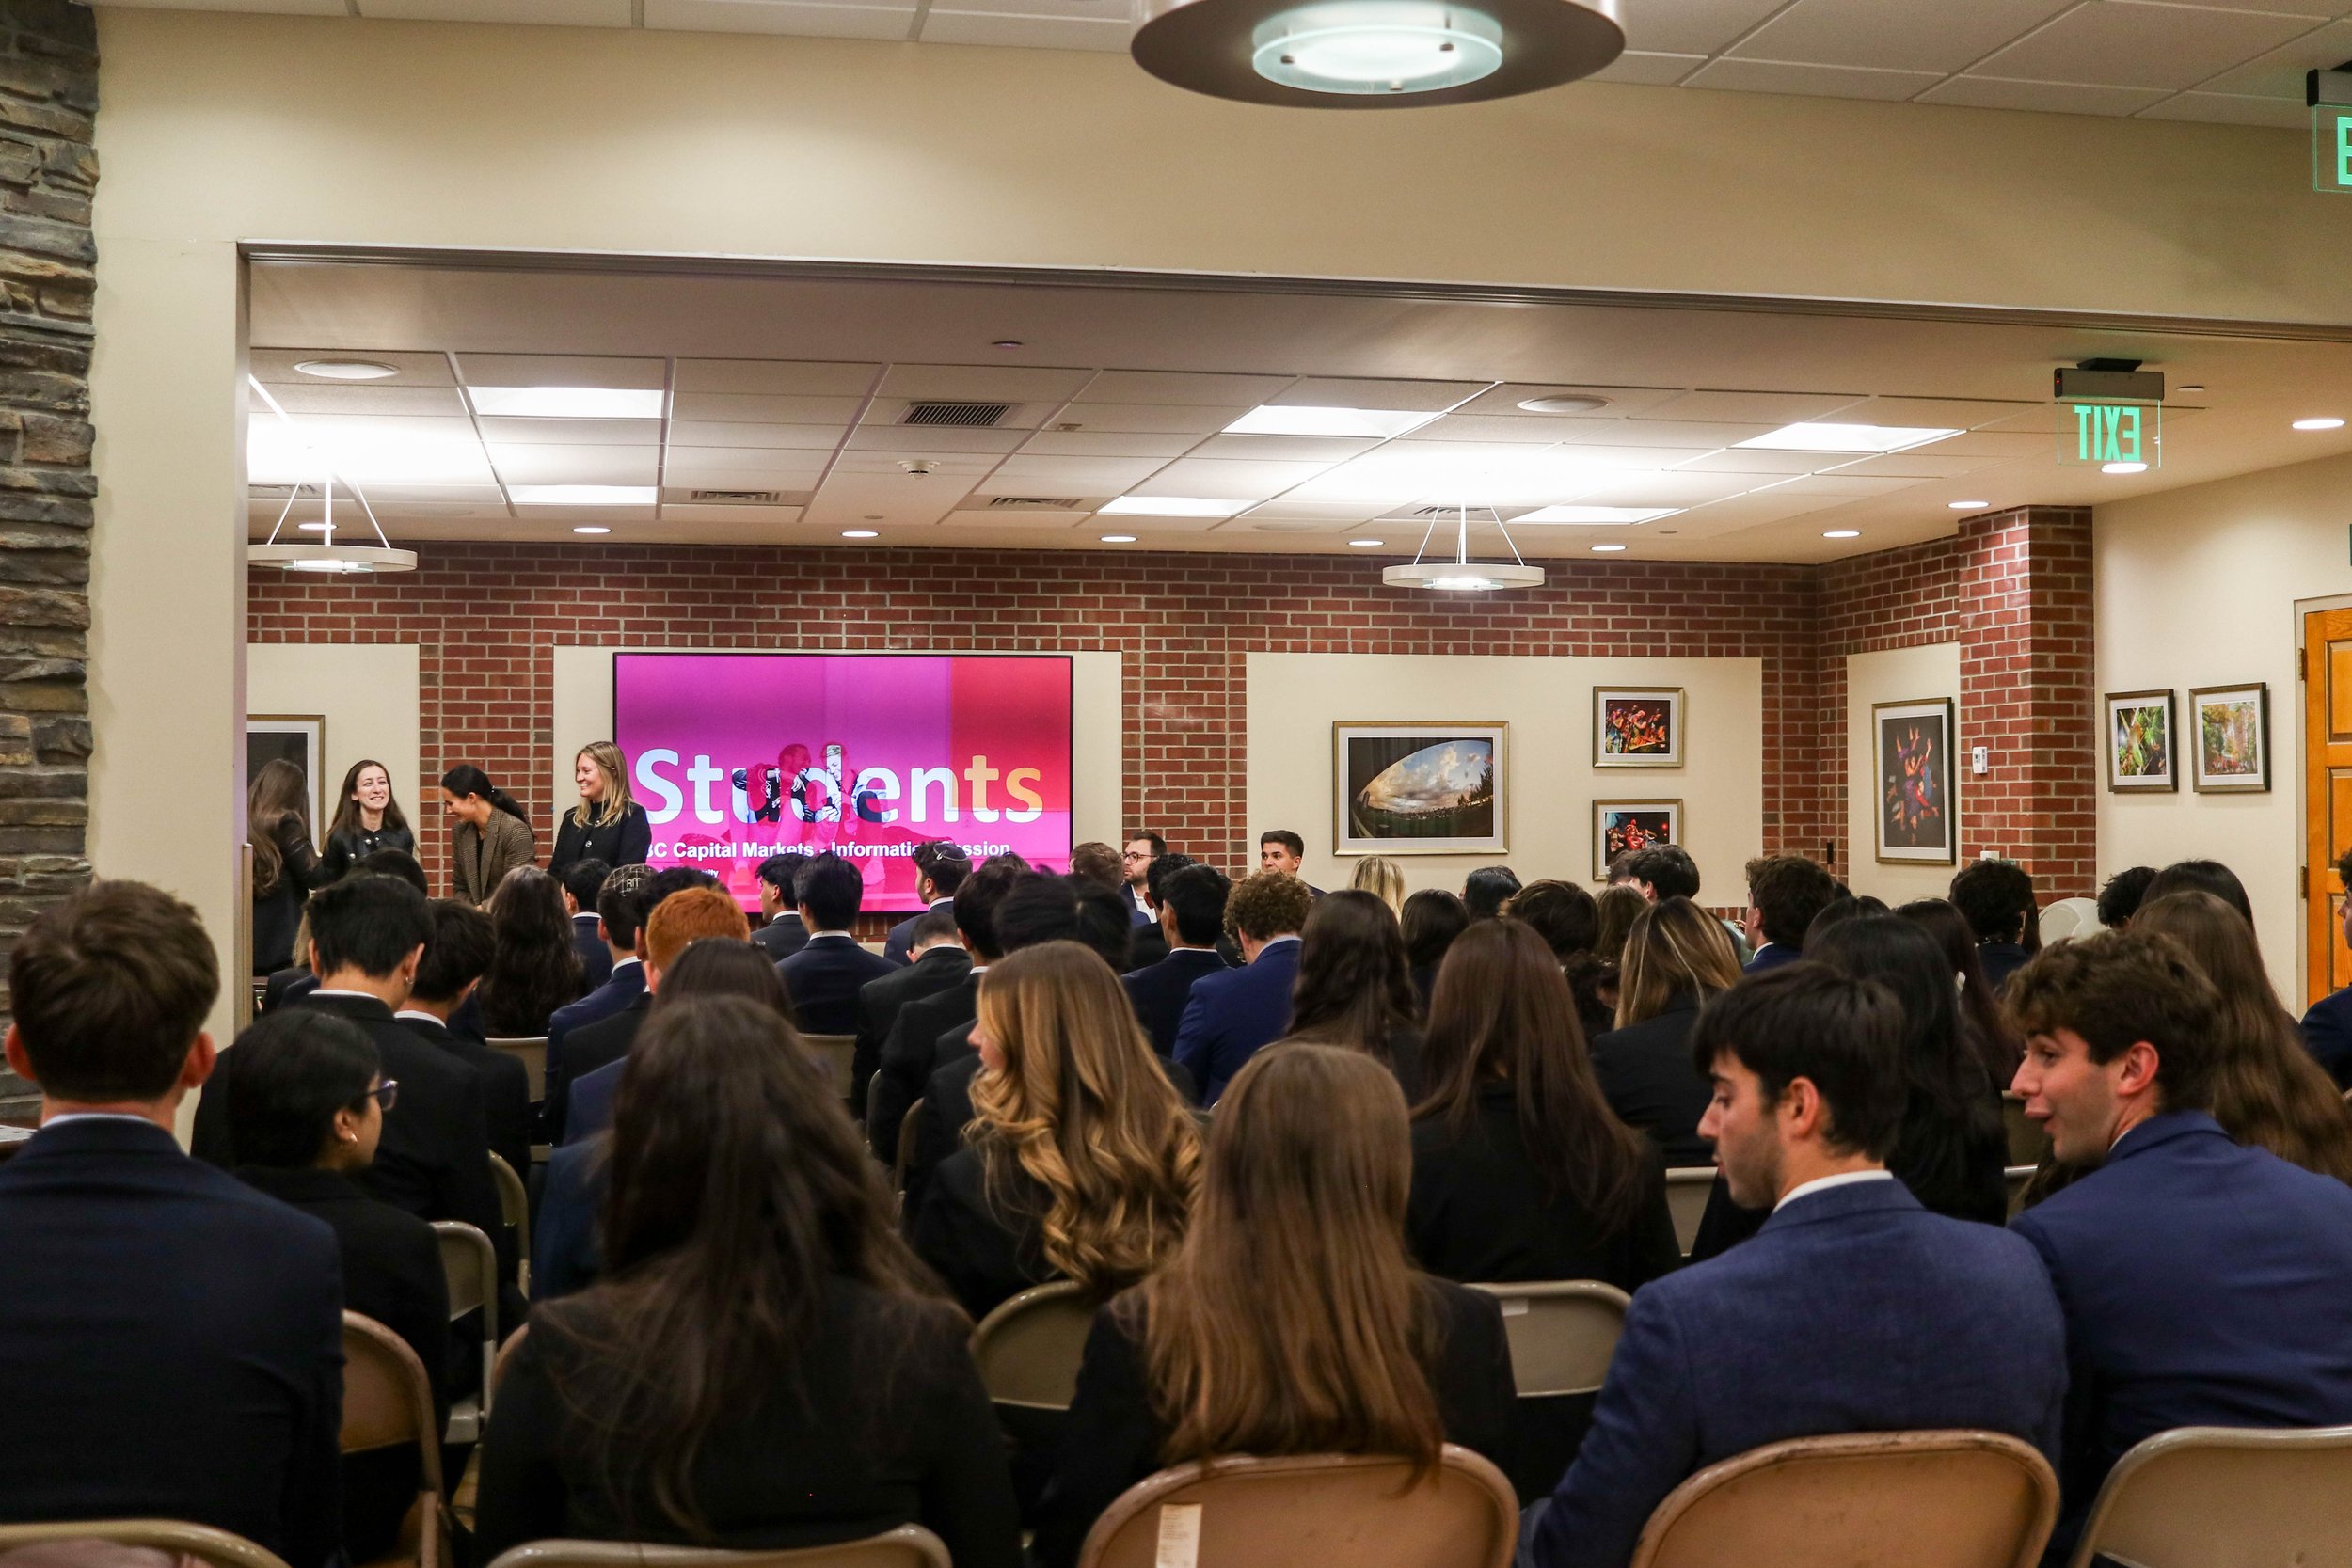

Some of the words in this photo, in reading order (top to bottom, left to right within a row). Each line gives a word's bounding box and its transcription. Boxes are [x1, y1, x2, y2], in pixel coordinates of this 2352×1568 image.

[635, 744, 1043, 824] Students
[673, 842, 737, 862] Capital
[832, 841, 916, 857] Informati
